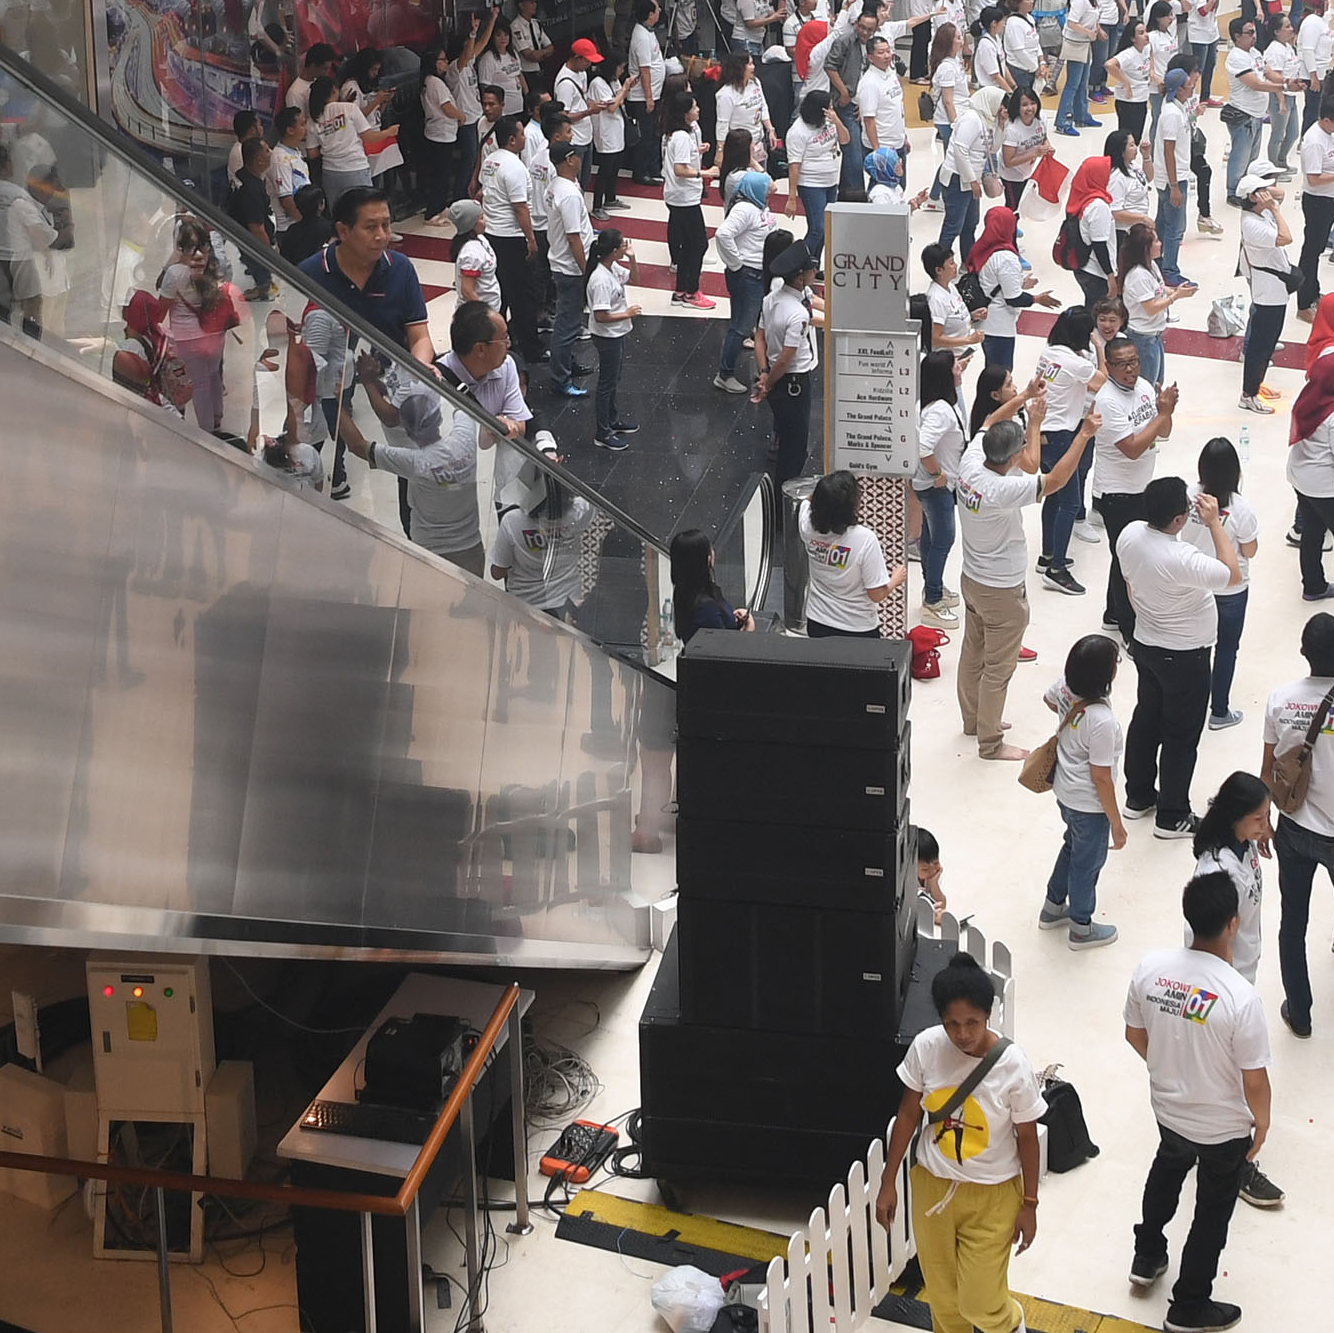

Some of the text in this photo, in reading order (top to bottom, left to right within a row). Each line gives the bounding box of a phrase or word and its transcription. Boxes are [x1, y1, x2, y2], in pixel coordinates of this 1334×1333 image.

[833, 253, 905, 271] GRAND
[833, 271, 904, 290] CITY
[905, 349, 910, 357] 4
[899, 409, 909, 418] L1
[846, 432, 856, 440] The
[857, 433, 873, 441] Grand
[900, 434, 907, 443] G
[847, 440, 864, 448] Marks
[870, 441, 892, 449] Spencer
[865, 462, 878, 471] Gym
[903, 460, 909, 468] G
[809, 539, 832, 549] JOKOWI
[828, 547, 848, 568] 01
[1284, 701, 1318, 711] JOKOWI
[1294, 709, 1316, 719] AMIN
[1155, 977, 1192, 994] JOKOWI
[1163, 988, 1188, 1000] AMIN
[1186, 991, 1214, 1020] 01
[1160, 1006, 1180, 1017] MAJU
